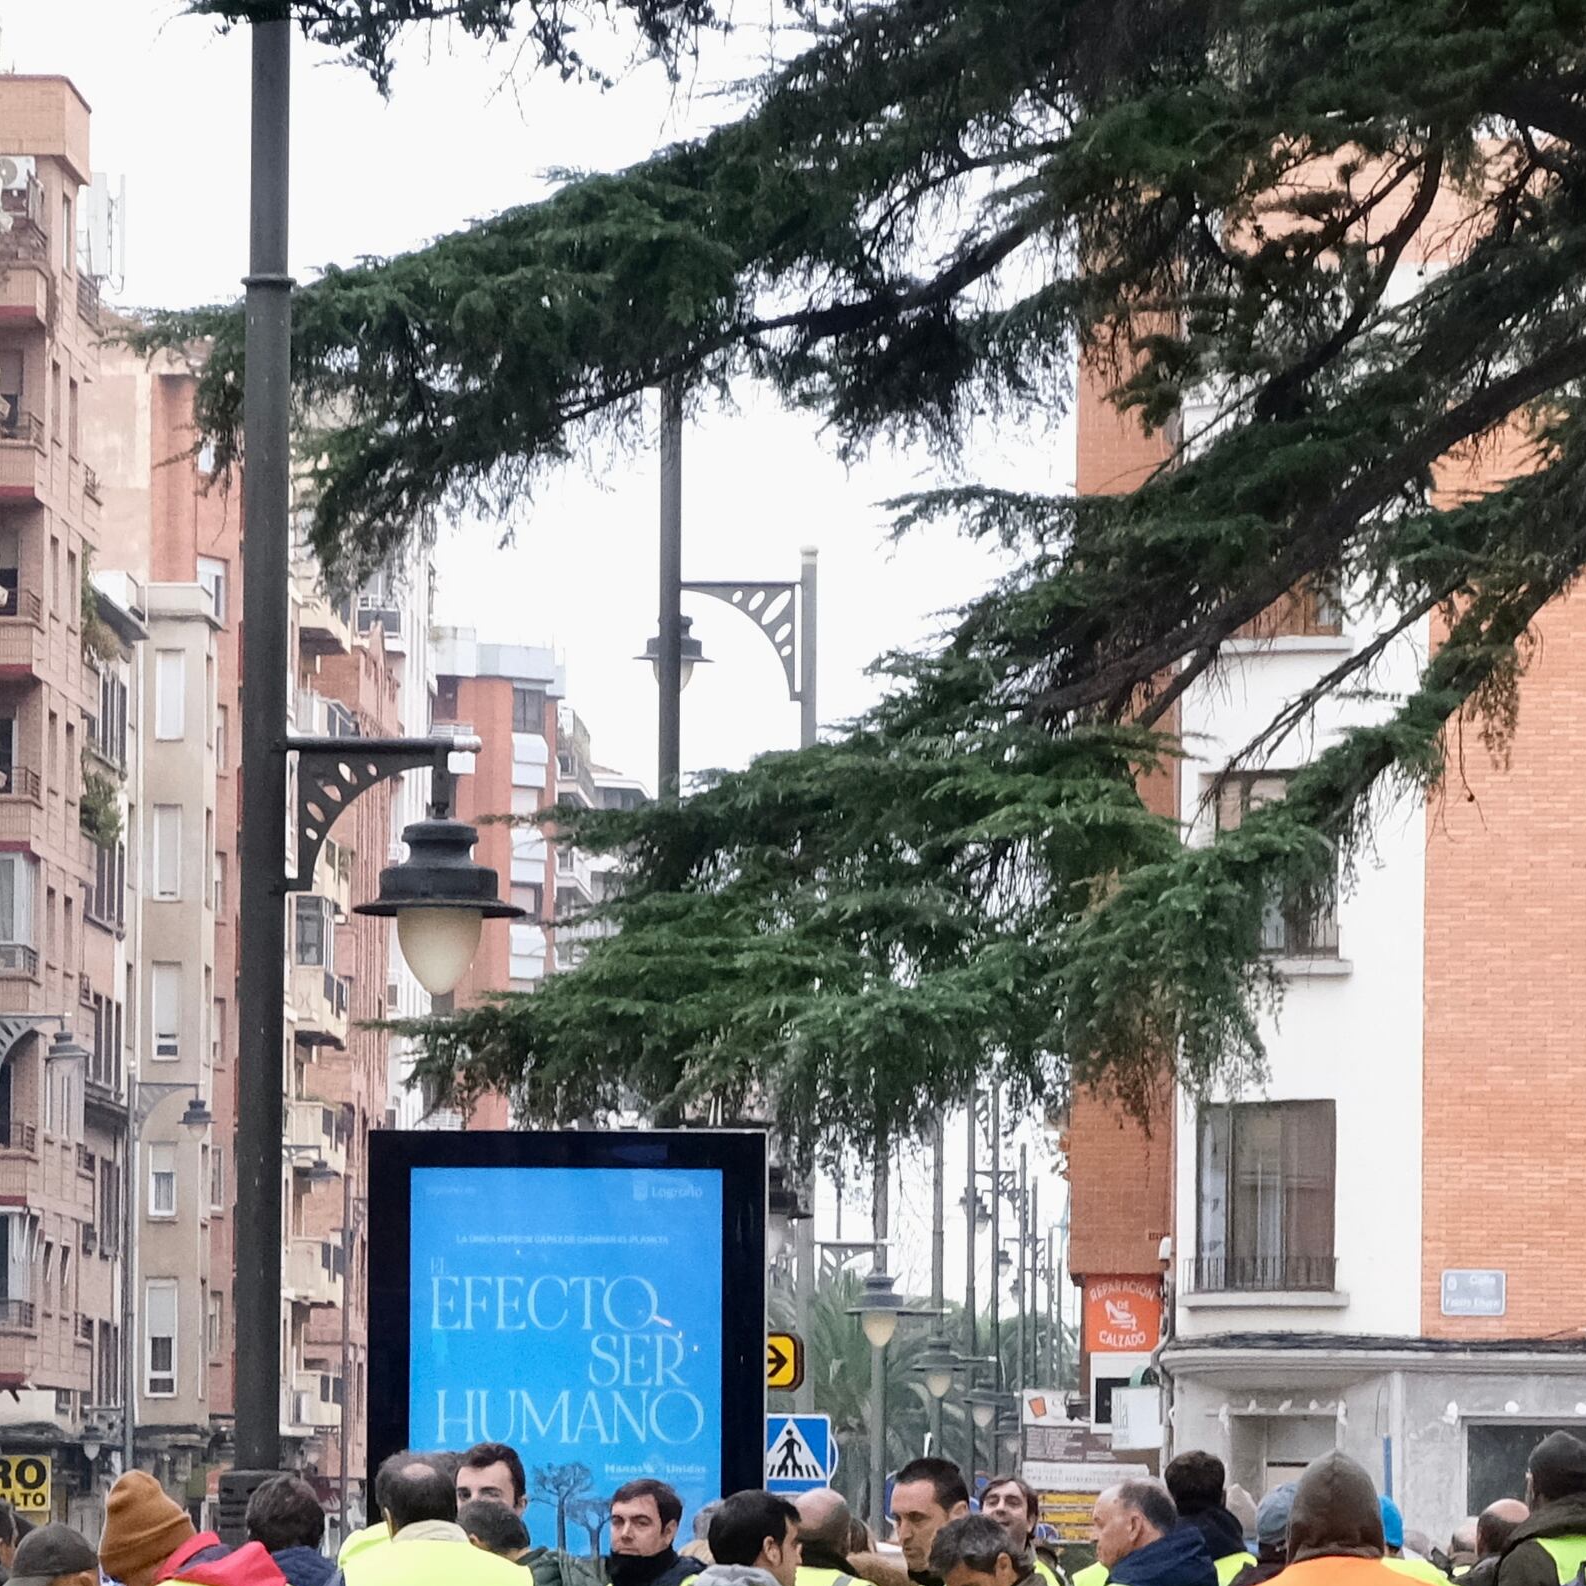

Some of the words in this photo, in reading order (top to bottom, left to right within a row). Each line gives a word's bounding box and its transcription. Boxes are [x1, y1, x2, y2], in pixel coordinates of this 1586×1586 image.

[431, 1275, 659, 1331] EFECTO
[1117, 1300, 1129, 1311] DE
[589, 1333, 689, 1386] SER
[1099, 1330, 1146, 1347] CALZADO
[436, 1389, 704, 1444] HUMANO
